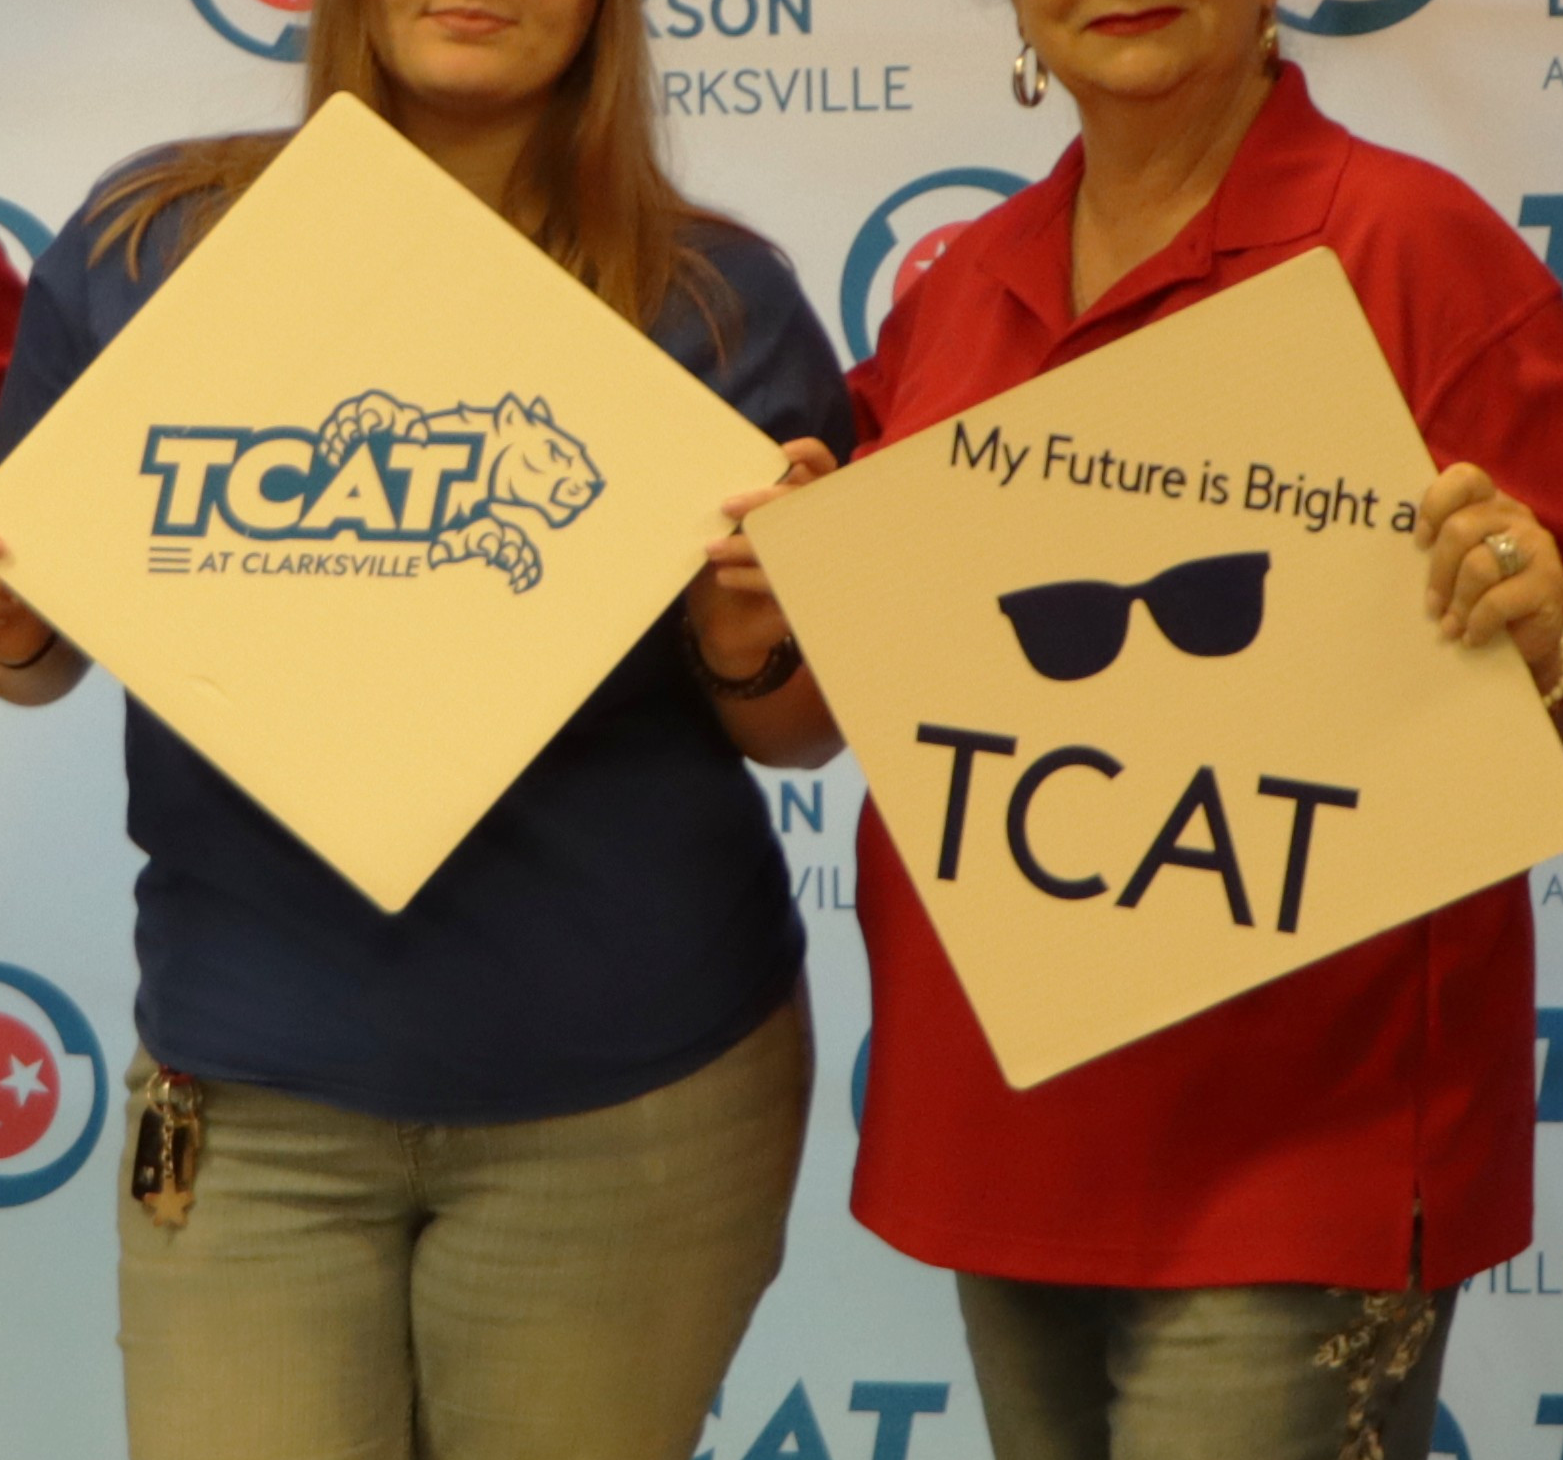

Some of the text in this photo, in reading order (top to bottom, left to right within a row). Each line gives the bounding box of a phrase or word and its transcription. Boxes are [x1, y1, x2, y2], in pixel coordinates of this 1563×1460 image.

[661, 65, 914, 118] RKSVILLE
[138, 424, 486, 542] TCAT
[949, 420, 1418, 534] My Future is Bright a
[196, 550, 422, 579] AT CLARKSVILLE
[915, 722, 1361, 935] TCAT
